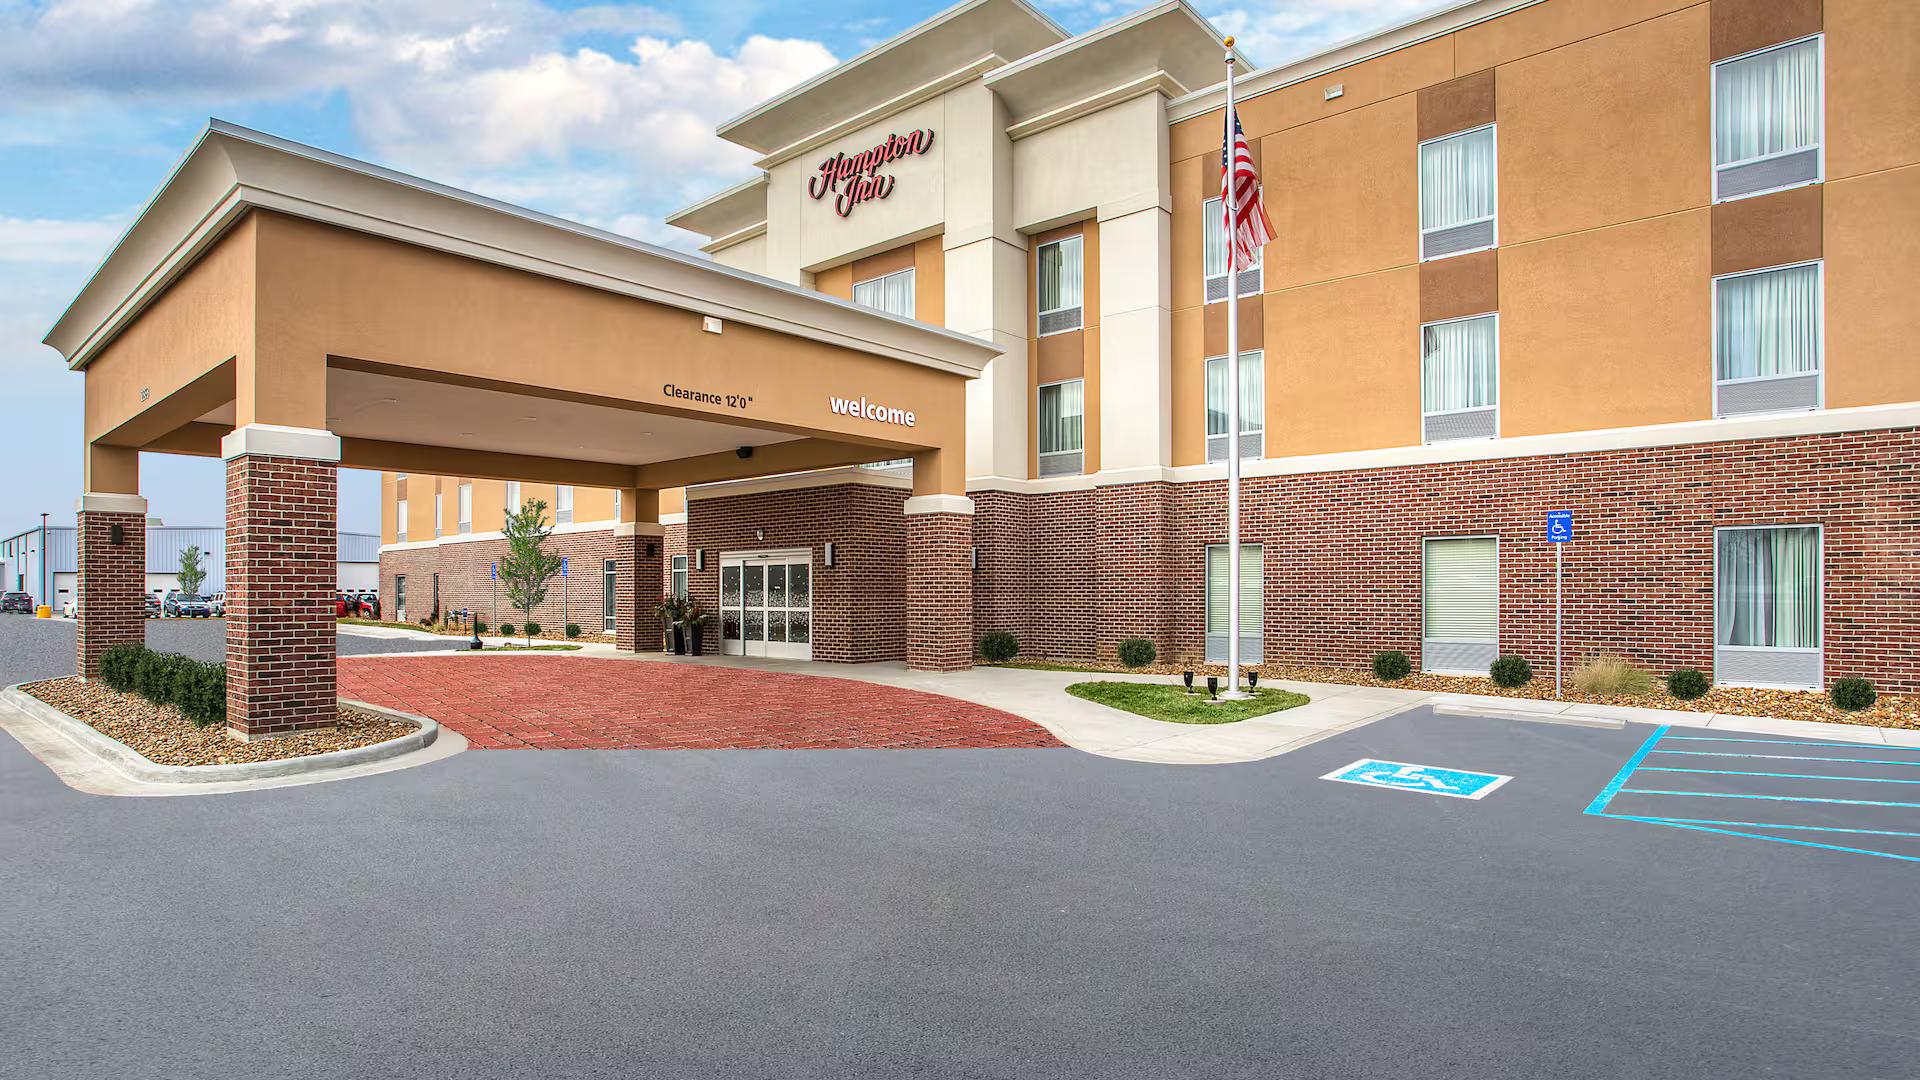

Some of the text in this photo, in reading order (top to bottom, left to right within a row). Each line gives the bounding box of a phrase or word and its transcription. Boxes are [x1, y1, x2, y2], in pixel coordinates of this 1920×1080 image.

[808, 128, 935, 200] Hampton
[834, 174, 896, 218] Inn
[663, 383, 722, 405] Clearance
[828, 396, 916, 427] welcome
